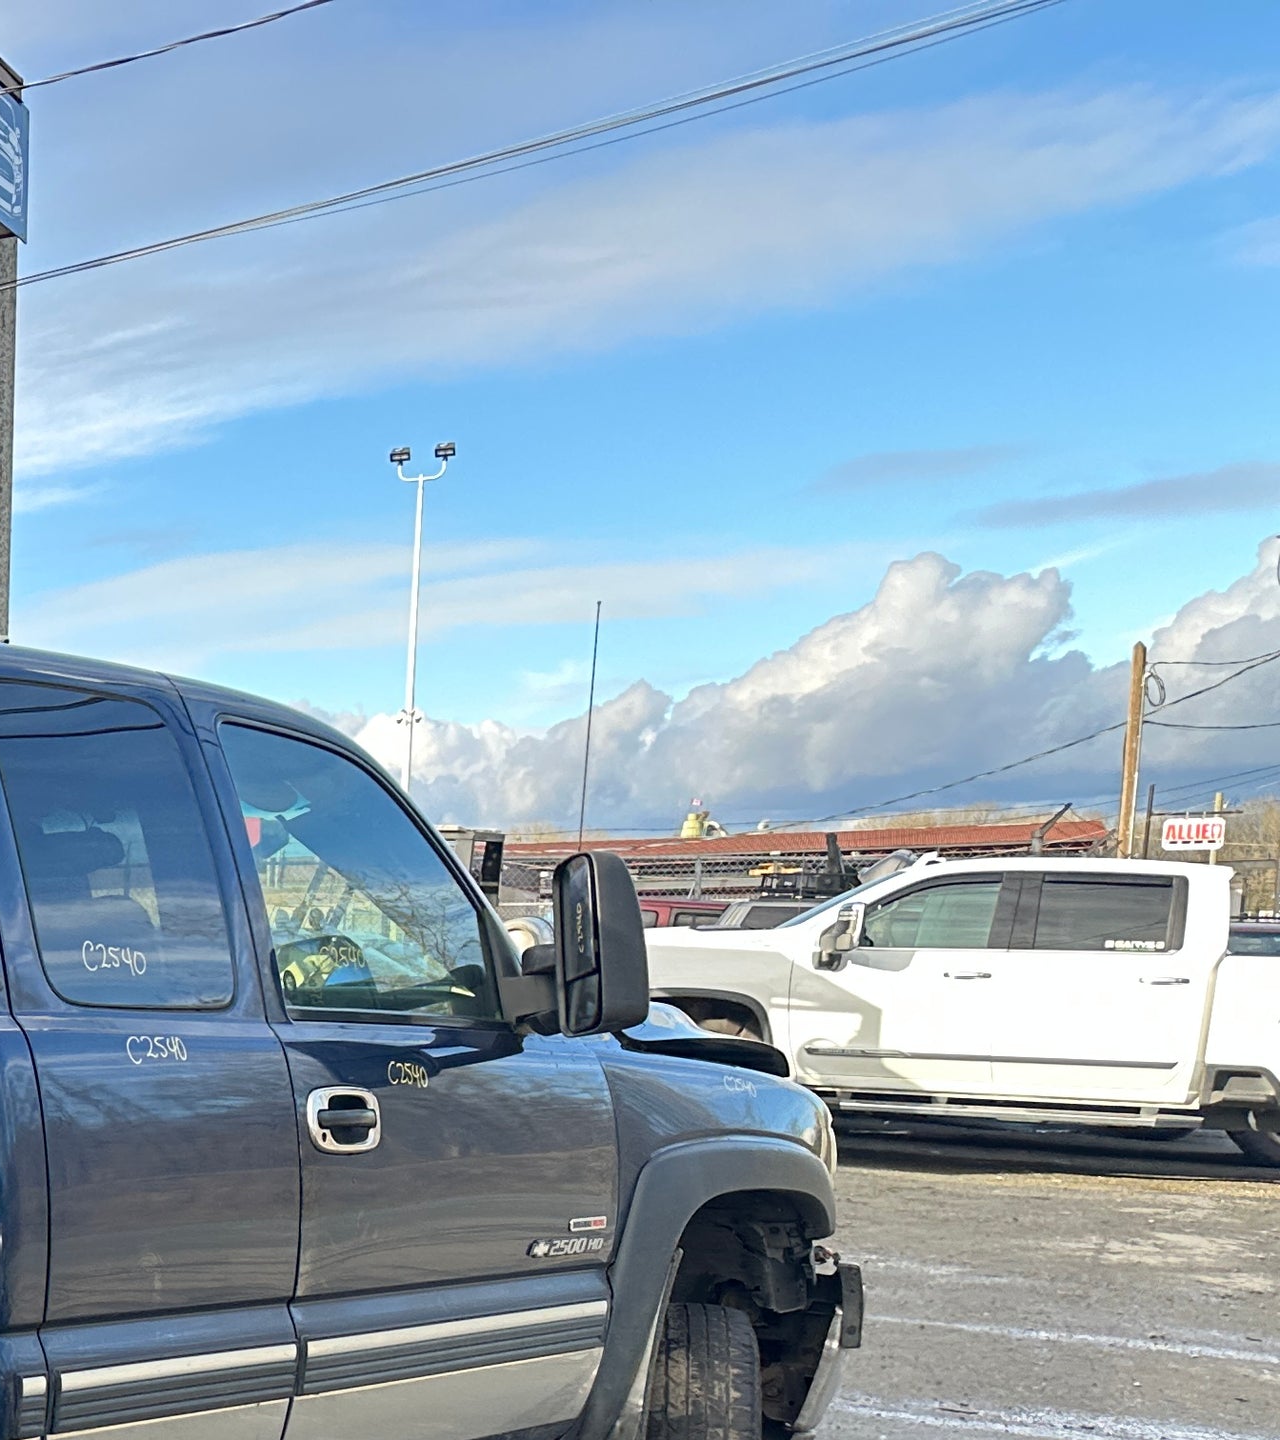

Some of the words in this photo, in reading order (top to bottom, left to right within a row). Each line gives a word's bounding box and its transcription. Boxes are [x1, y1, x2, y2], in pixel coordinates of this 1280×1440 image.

[82, 940, 147, 977] C2540
[319, 945, 366, 970] C2540
[126, 1034, 188, 1065] C2540
[387, 1060, 429, 1089] C2540
[549, 1237, 586, 1256] 2500
[587, 1237, 604, 1250] HD
